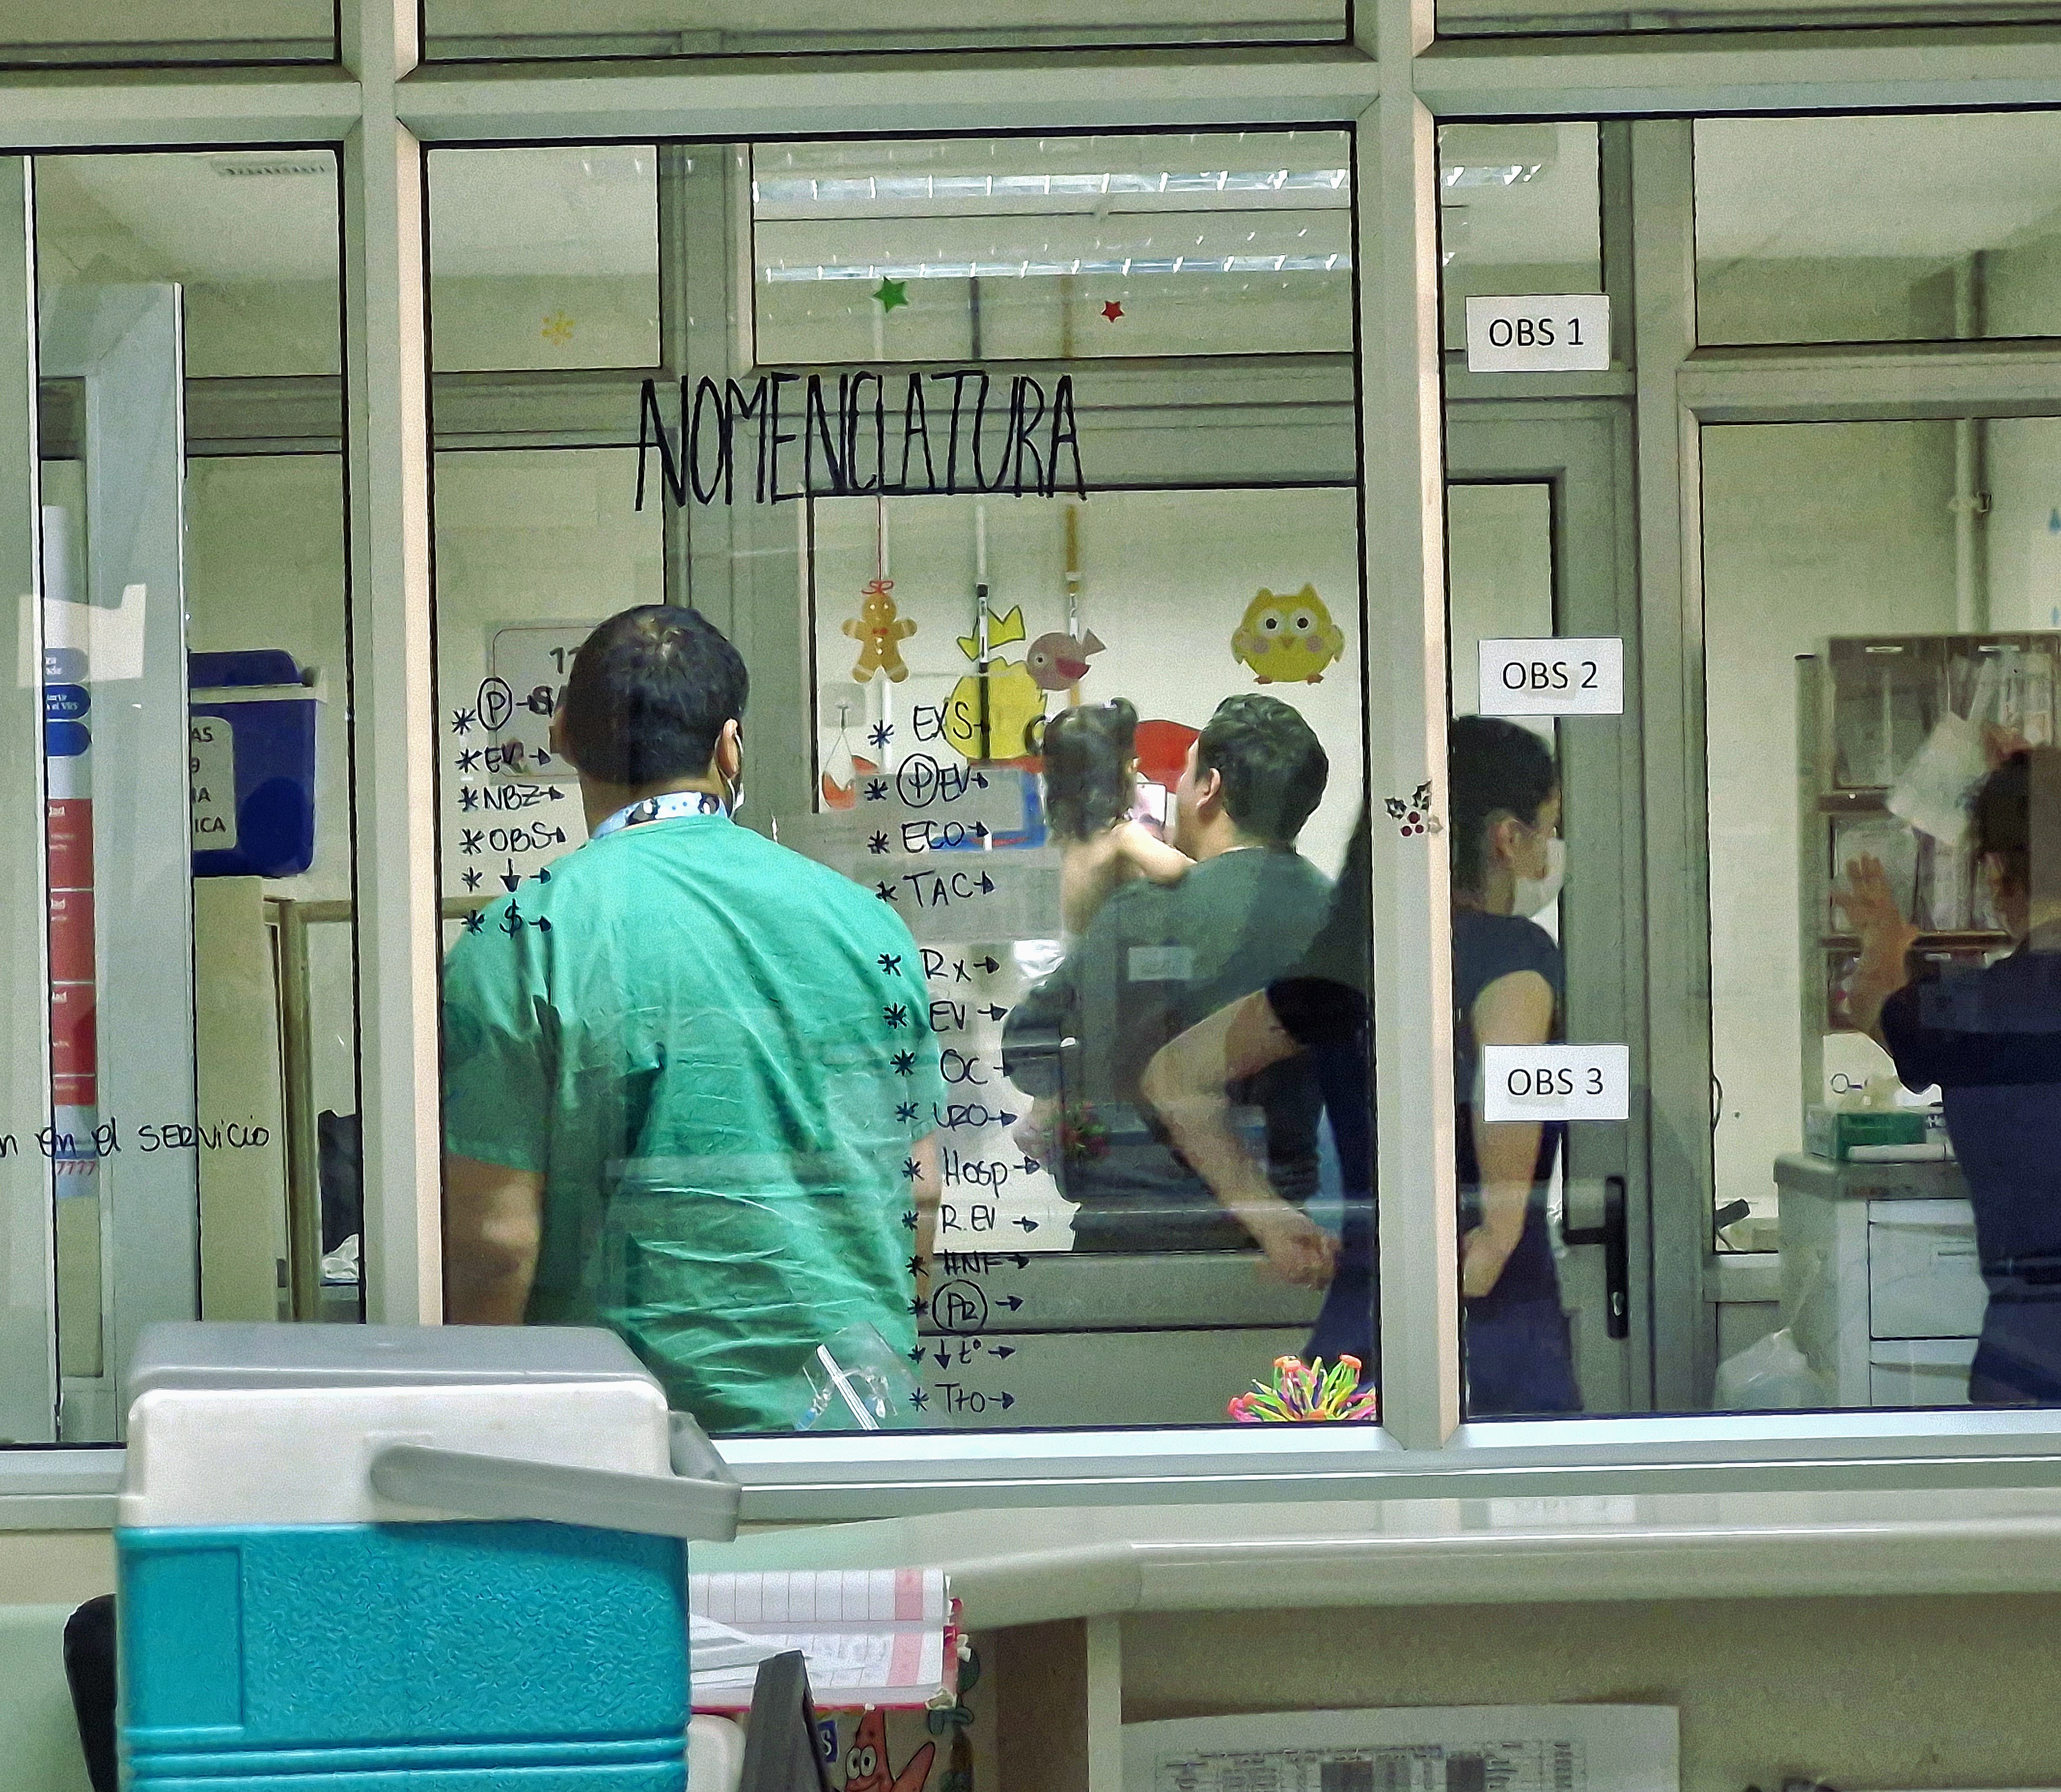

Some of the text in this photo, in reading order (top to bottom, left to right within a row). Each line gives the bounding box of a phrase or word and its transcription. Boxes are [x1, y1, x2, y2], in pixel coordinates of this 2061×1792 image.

[1489, 318, 1584, 346] OBS 1
[634, 372, 1087, 511] NOMENCLATURA
[1502, 661, 1599, 689] OBS 2
[913, 701, 972, 742] EXS
[483, 785, 542, 811] NBZ
[489, 822, 552, 852] OBS
[901, 820, 965, 853] ECO
[902, 870, 974, 908] TAC
[930, 1001, 965, 1032] EV
[1508, 1067, 1603, 1096] OBS 3
[34, 1127, 78, 1159] en
[91, 1116, 122, 1157] el
